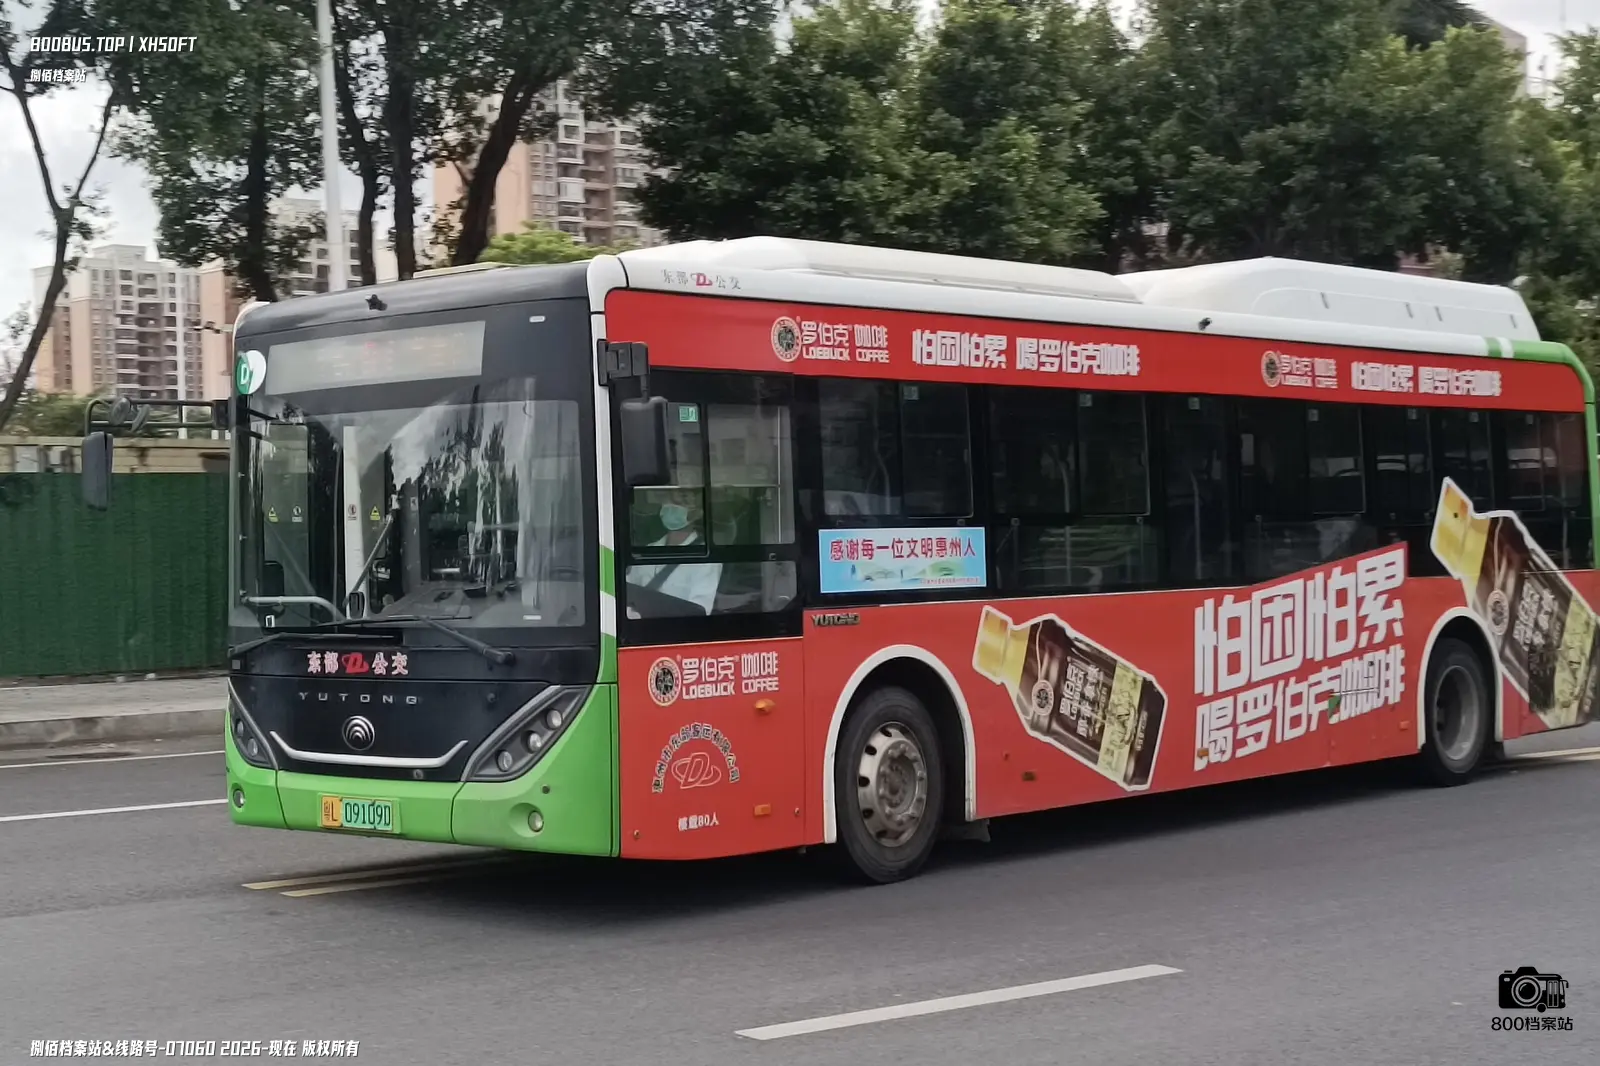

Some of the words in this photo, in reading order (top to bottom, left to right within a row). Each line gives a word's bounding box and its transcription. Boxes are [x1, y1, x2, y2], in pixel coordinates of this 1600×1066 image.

[801, 321, 850, 347] 罗伯克
[854, 324, 888, 348] 咖啡
[802, 346, 850, 361] LOEBUCK
[855, 349, 890, 363] COFFEE
[912, 328, 1008, 369] 怕困怕累
[1016, 336, 1140, 376] 喝罗伯克咖啡
[830, 537, 976, 561] 感谢每一位文明惠州人
[1194, 549, 1405, 696] 怕困怕累
[682, 655, 736, 684] 罗伯克
[741, 651, 778, 678] 咖啡
[298, 692, 418, 704] YUTONG
[682, 681, 735, 700] LOEBUCK
[742, 677, 779, 693] COFFEE
[1194, 643, 1406, 771] 喝罗伯克咖啡
